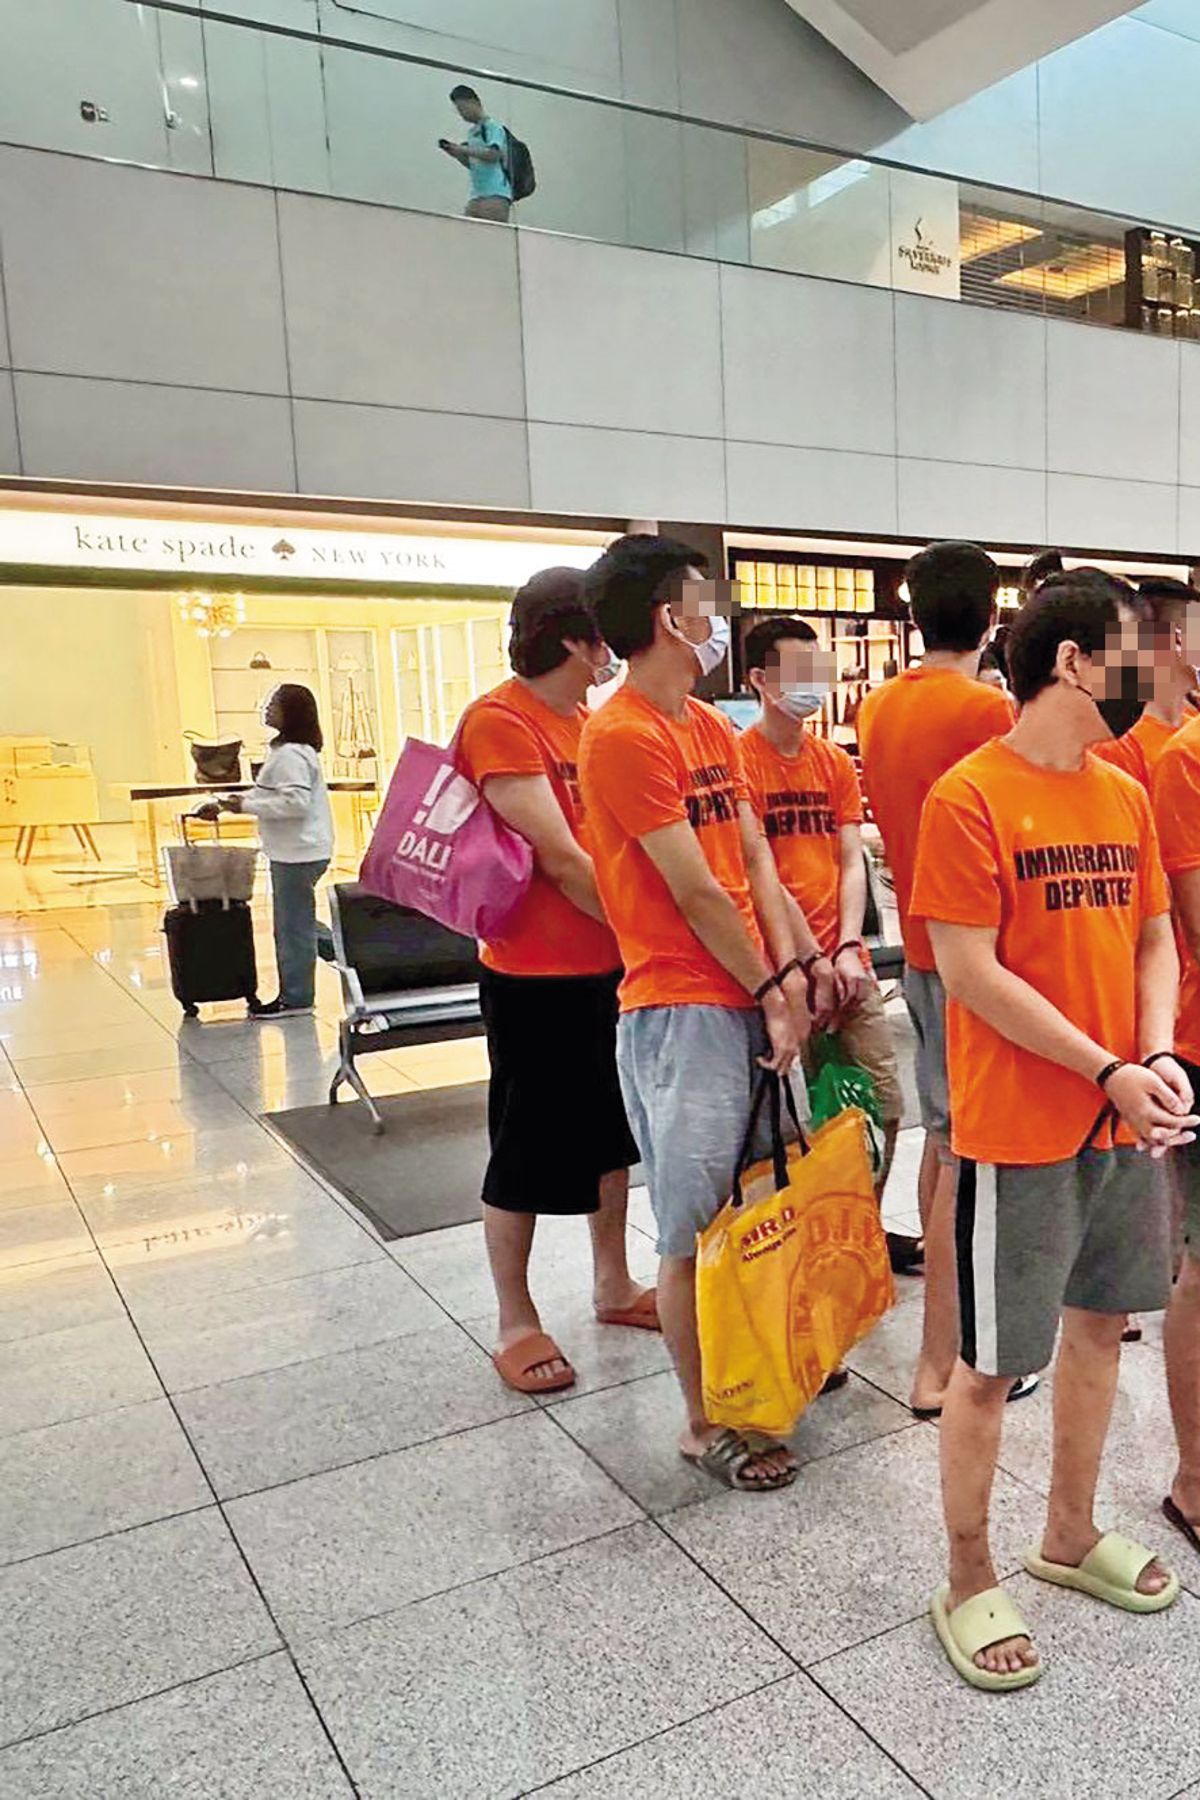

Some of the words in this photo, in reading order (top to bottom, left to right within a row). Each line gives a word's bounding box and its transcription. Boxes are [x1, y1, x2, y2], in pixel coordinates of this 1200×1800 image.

[75, 526, 148, 553] kate
[162, 536, 255, 563] spade
[311, 546, 367, 565] NEW
[380, 551, 446, 570] YORK
[397, 830, 452, 872] DALI
[1014, 843, 1138, 880] IMMIGRATIO
